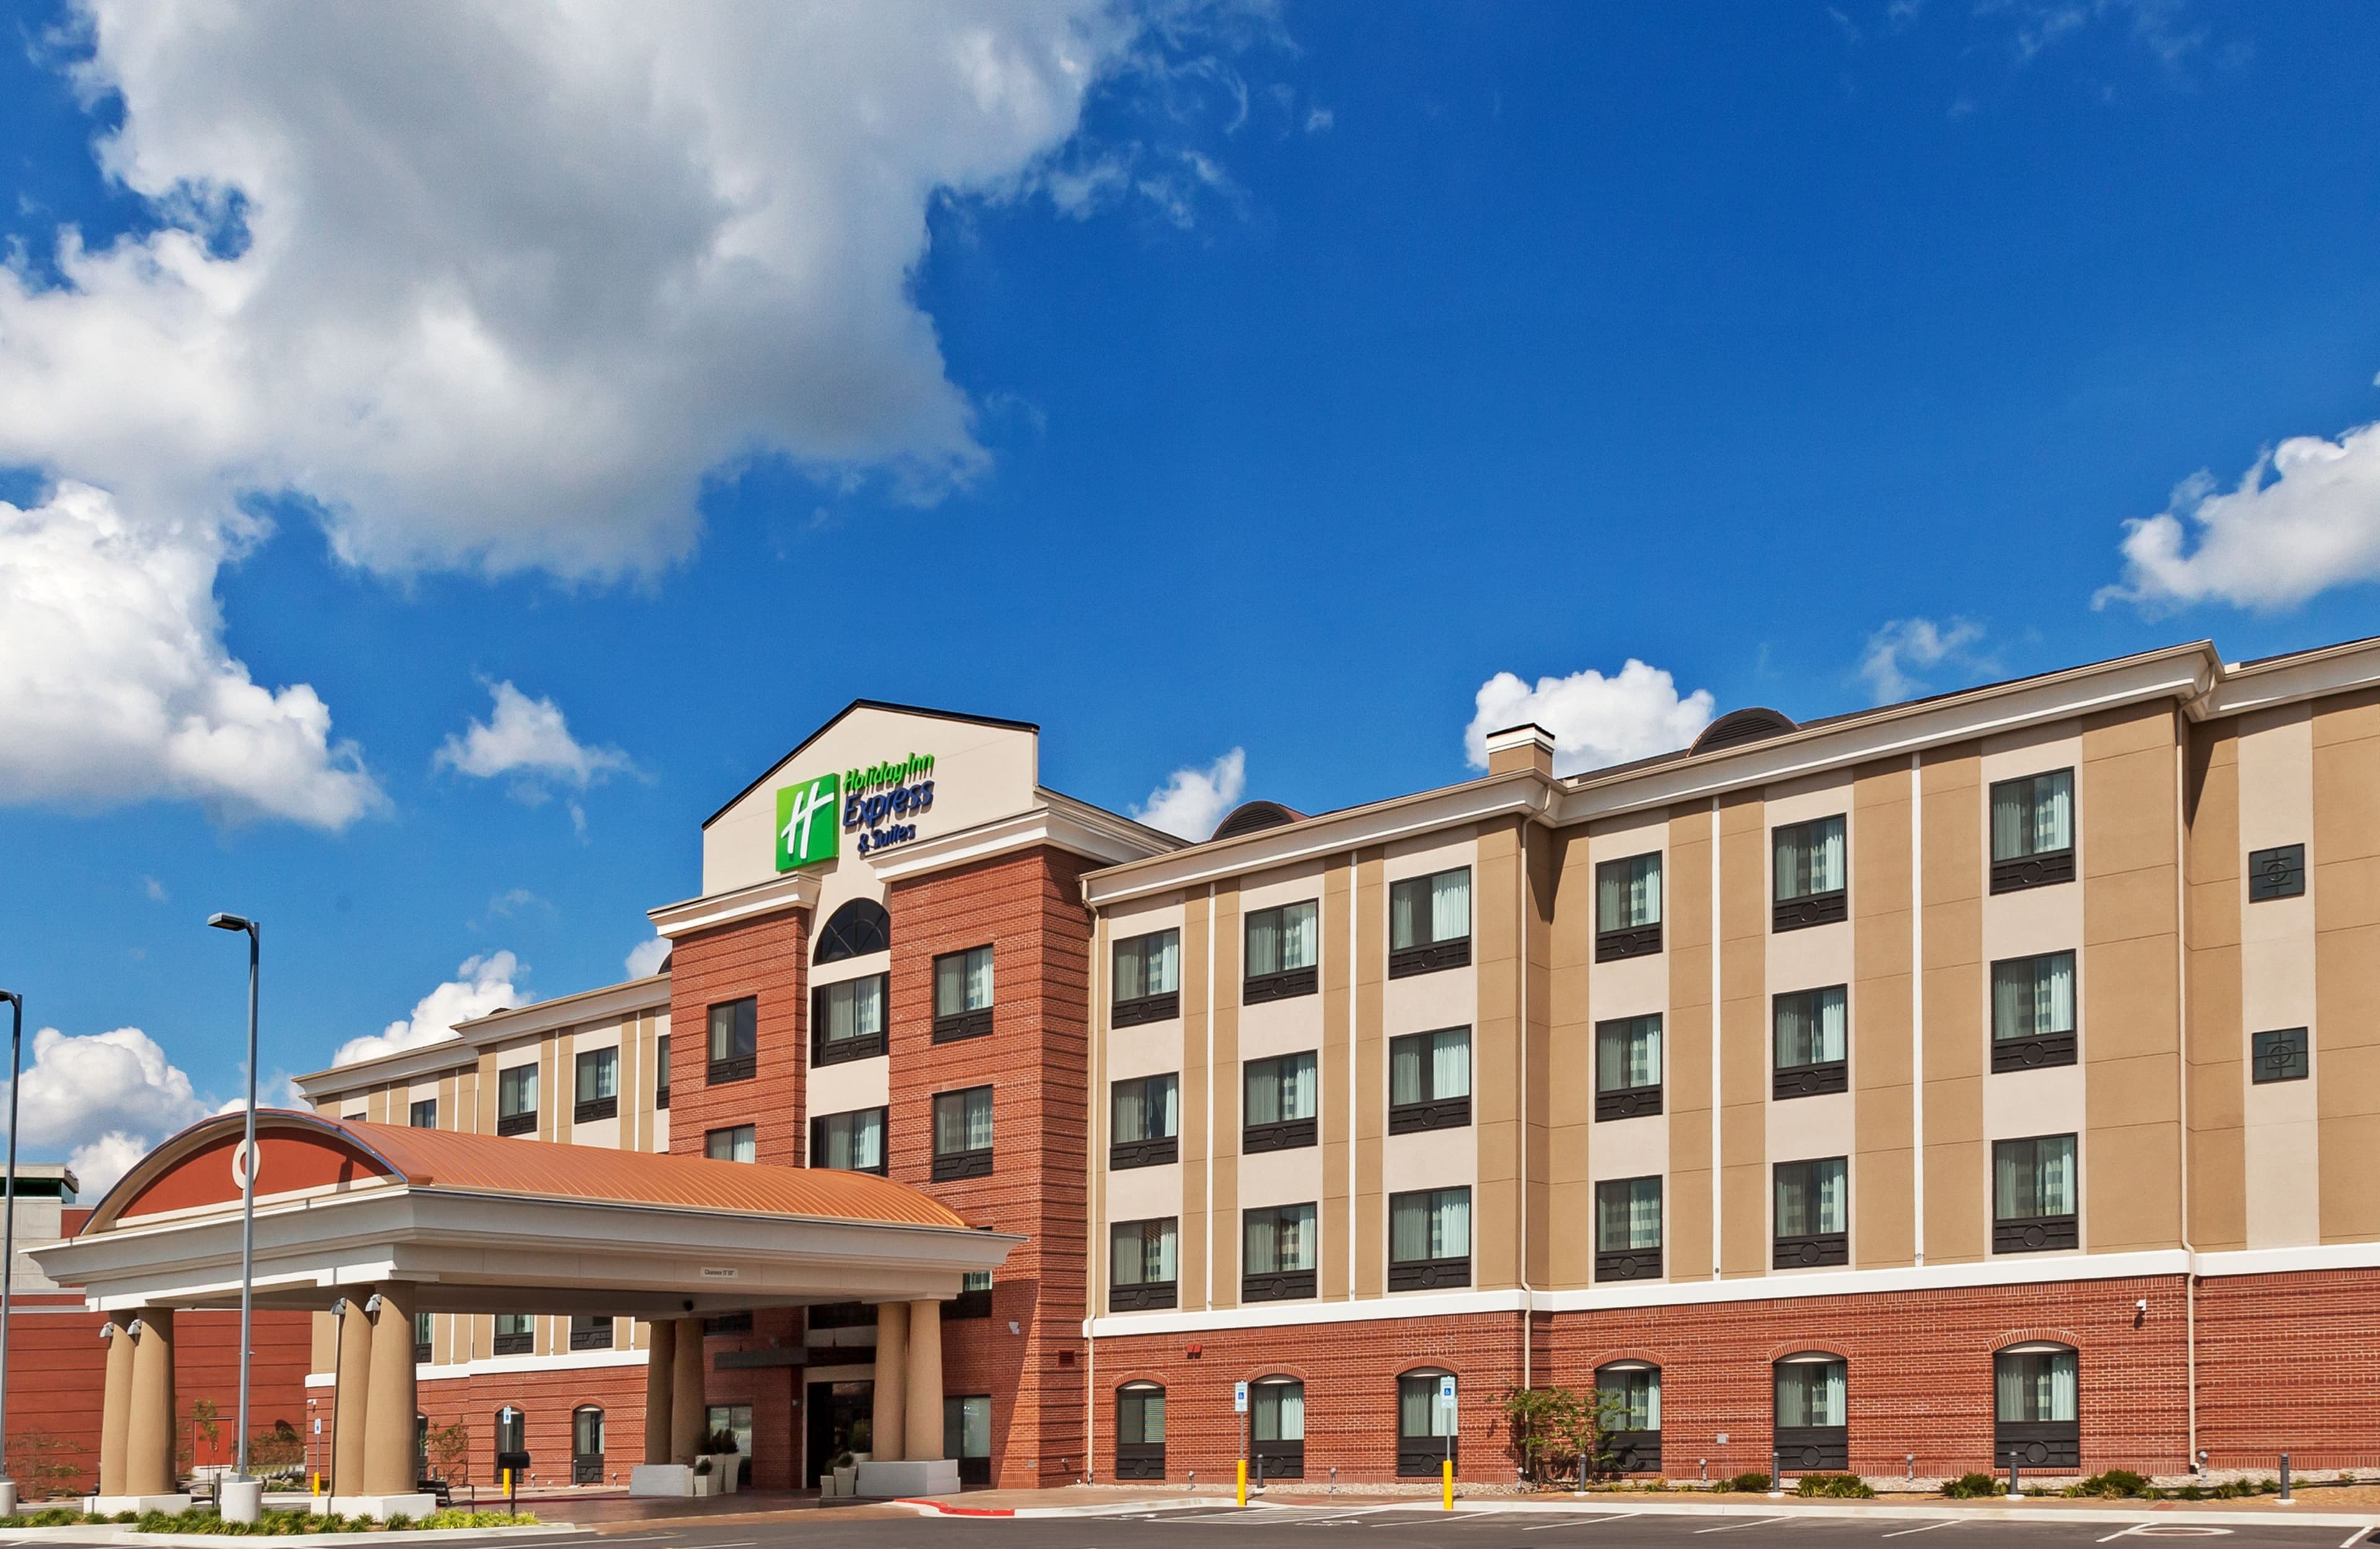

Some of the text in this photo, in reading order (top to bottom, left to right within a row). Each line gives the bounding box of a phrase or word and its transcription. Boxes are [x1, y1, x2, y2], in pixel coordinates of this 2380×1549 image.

[844, 752, 935, 792] Holiday Inn
[843, 781, 935, 828] Express
[857, 824, 916, 852] & Suites
